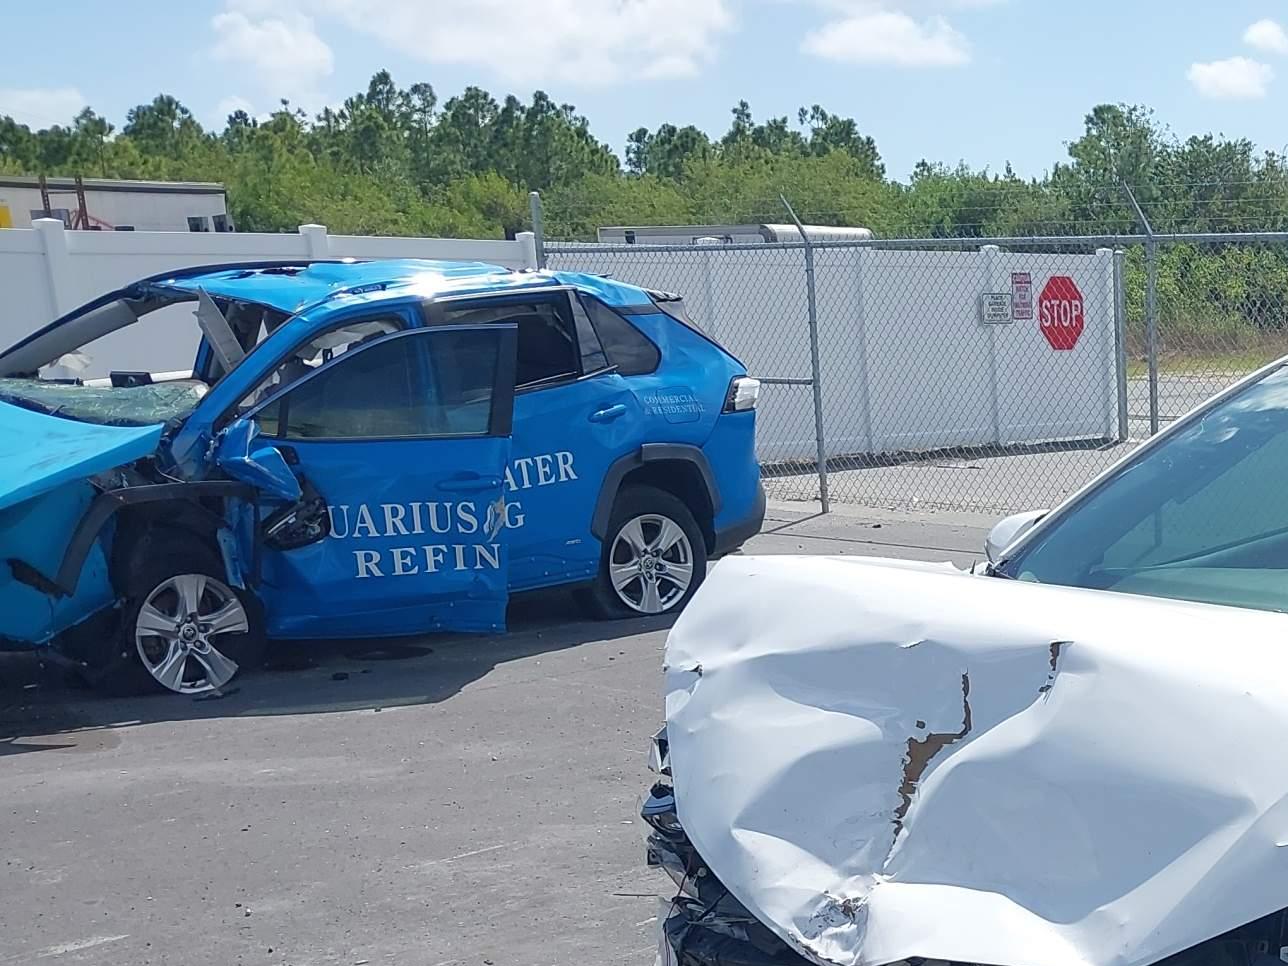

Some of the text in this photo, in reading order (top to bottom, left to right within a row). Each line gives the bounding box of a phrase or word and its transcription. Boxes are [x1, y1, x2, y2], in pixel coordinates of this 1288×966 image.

[1041, 299, 1081, 327] STOP
[643, 394, 699, 405] COMMERCIAL
[652, 404, 704, 415] RESIDENTIAL
[352, 543, 501, 579] REFIN
